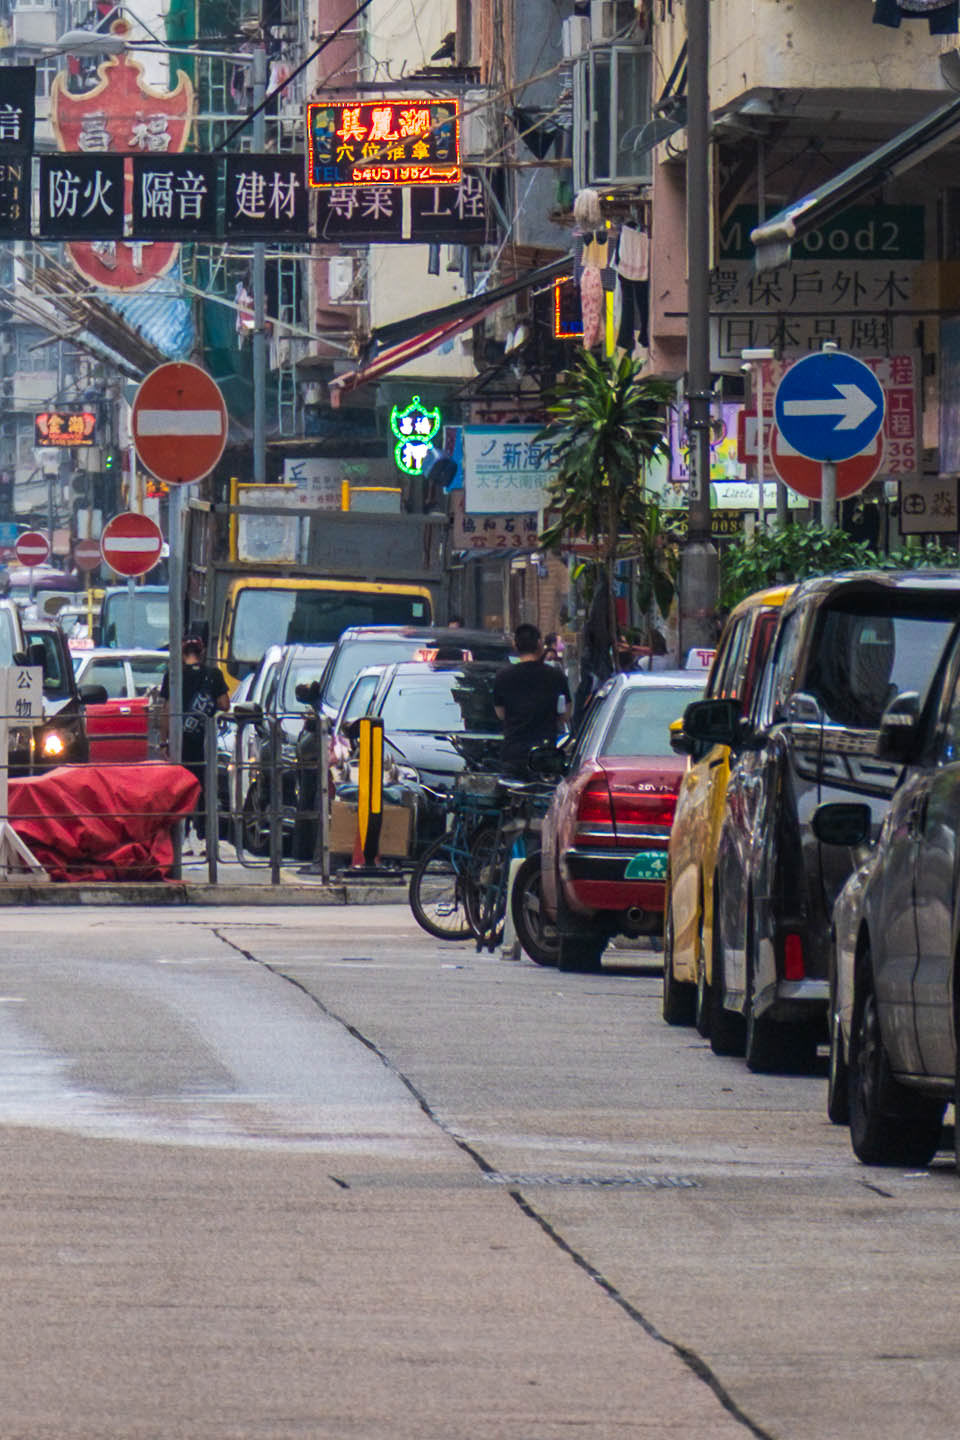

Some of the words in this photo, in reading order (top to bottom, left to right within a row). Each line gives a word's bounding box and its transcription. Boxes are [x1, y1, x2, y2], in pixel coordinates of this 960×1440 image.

[49, 169, 114, 218] 防火
[142, 170, 207, 219] 隔音
[234, 170, 300, 219] 建材
[327, 188, 393, 219] 專業
[420, 175, 486, 219] 工程
[15, 670, 33, 717] 公物
